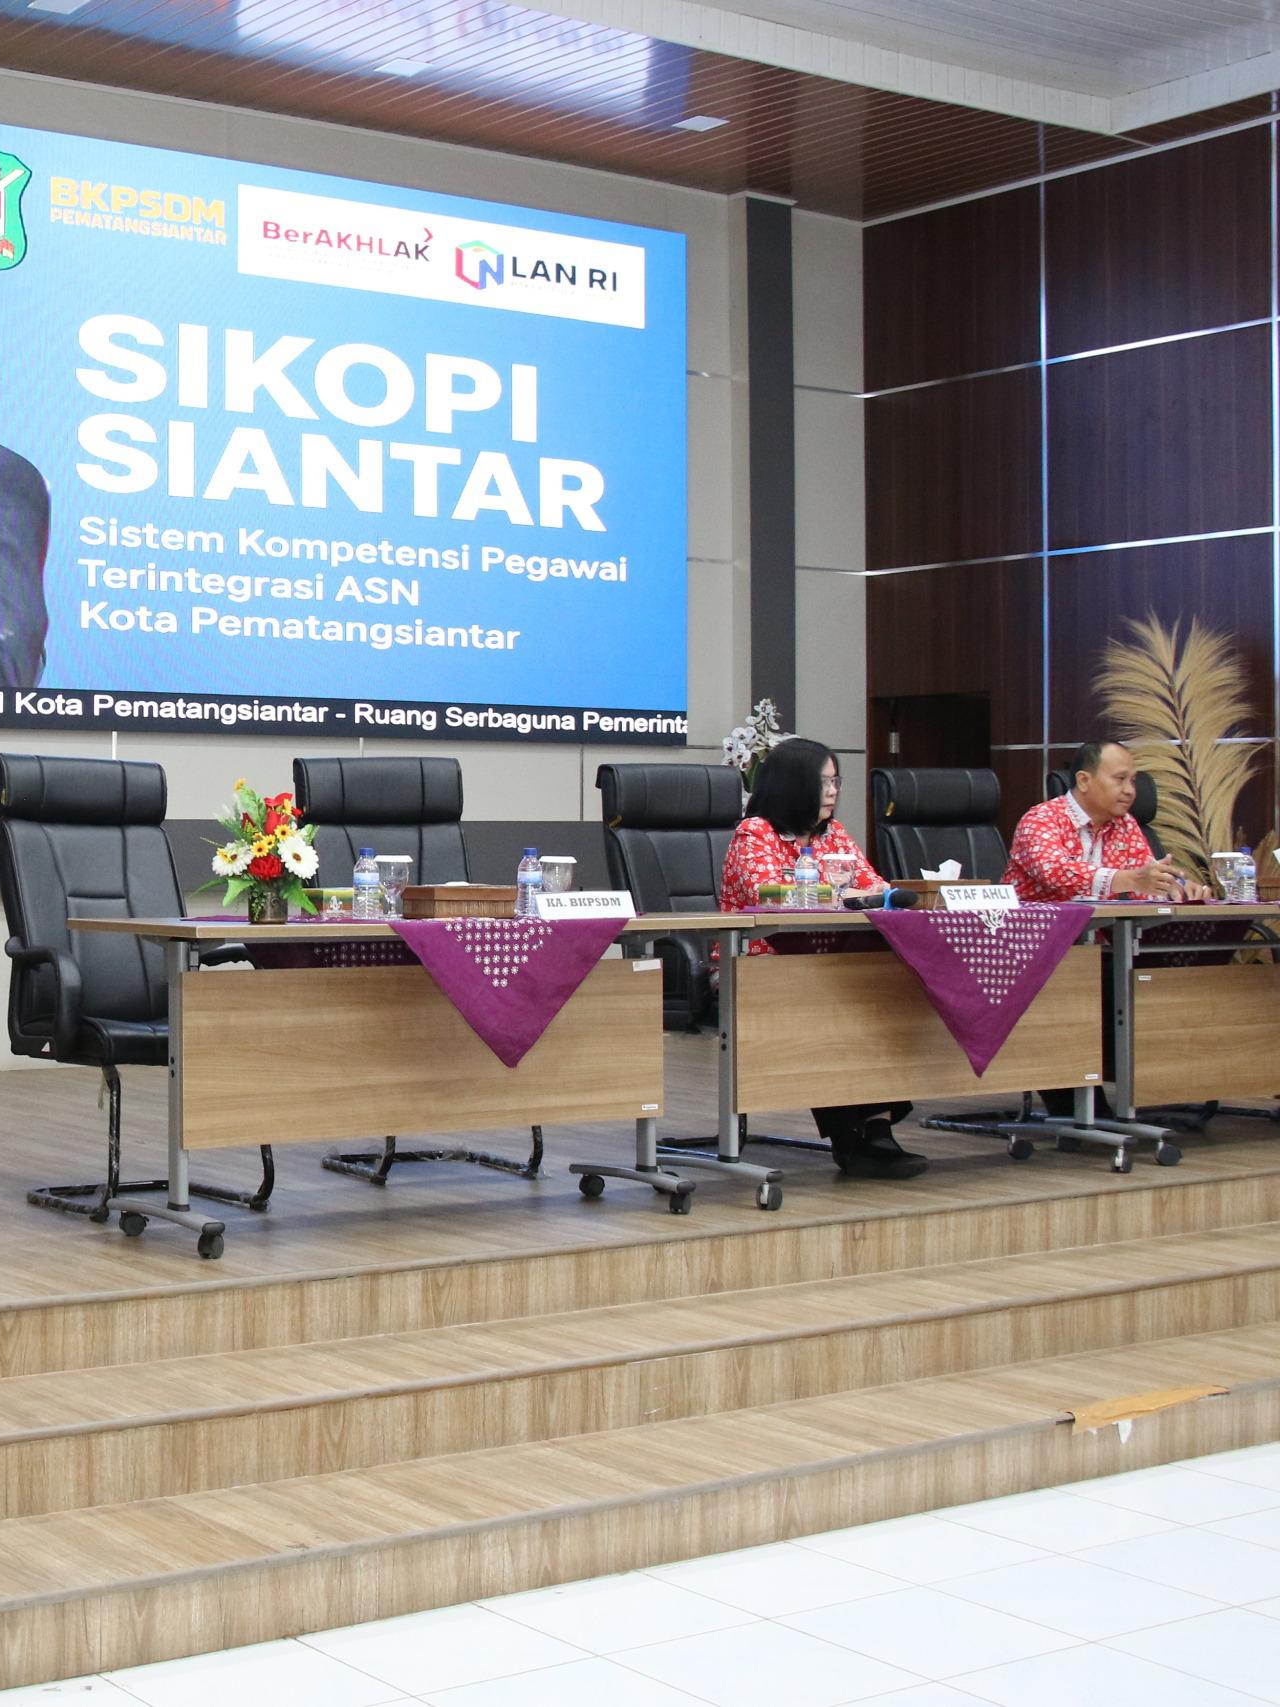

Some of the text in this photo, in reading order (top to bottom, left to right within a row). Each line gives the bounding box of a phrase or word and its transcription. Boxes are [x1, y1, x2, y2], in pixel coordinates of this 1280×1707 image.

[50, 176, 225, 228] BKPSDM
[49, 207, 228, 246] PEMATANGSIANTAR
[263, 220, 431, 262] BerAKHLAK
[512, 256, 577, 286] LAN
[588, 267, 617, 292] RI
[76, 313, 538, 443] SIKOPI
[75, 413, 607, 532] SIANTAR
[79, 516, 628, 583] Sistem Kompetensi Pegawai
[77, 558, 420, 606] Terintegrasi ASN
[79, 600, 521, 650] Kota Pematangsiantar
[15, 691, 83, 716] Kota
[93, 695, 329, 725] Pematangsiantar
[354, 703, 437, 731] Ruang
[445, 706, 576, 734] Serbaguna
[546, 897, 622, 907] KA. BKPSDM
[946, 887, 1010, 901] STAF AHLI
